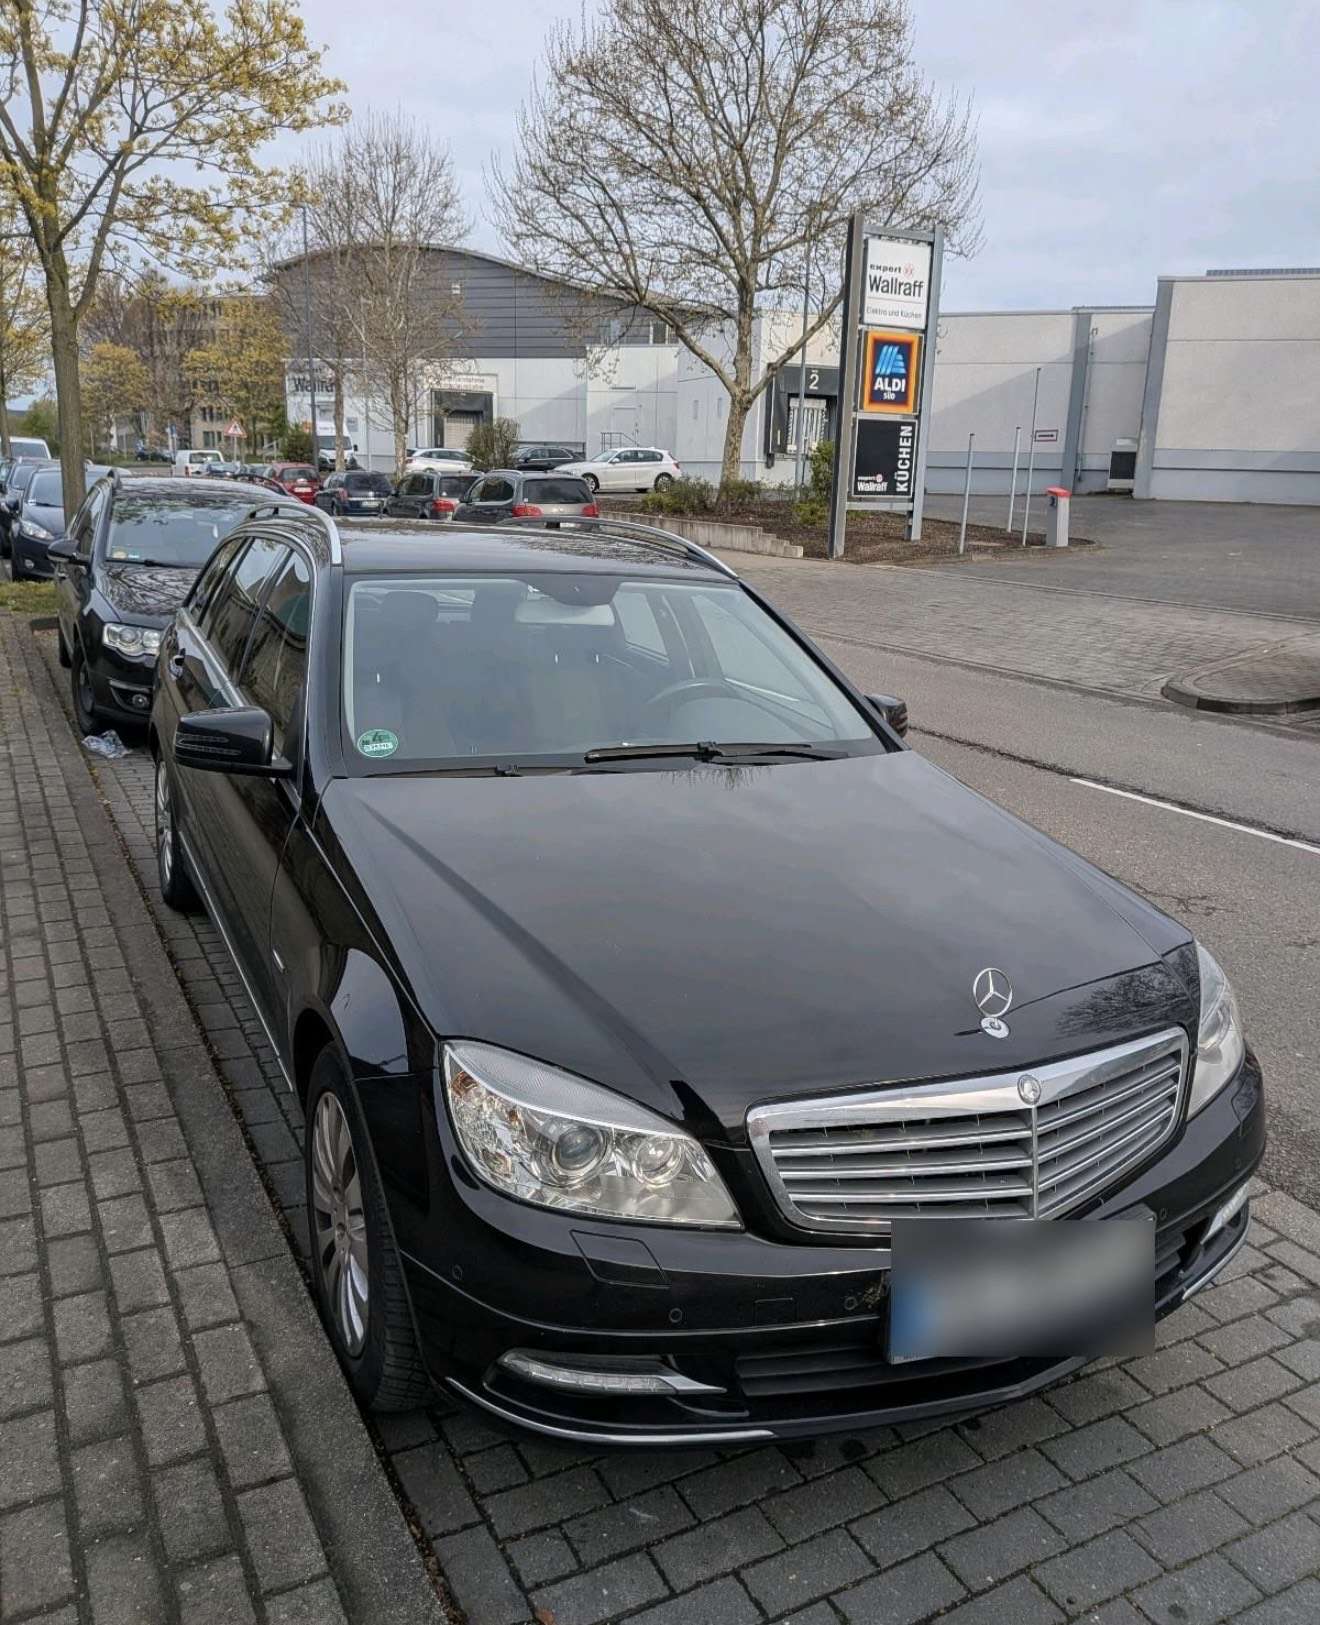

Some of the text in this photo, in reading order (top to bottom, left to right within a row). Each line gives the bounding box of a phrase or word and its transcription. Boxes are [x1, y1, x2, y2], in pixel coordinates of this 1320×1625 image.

[869, 263, 901, 274] expert
[868, 274, 925, 297] Wallraff
[809, 373, 819, 390] 2
[874, 376, 906, 392] ALDI
[894, 425, 913, 492] KÜCHEN
[857, 481, 888, 492] Wallraff
